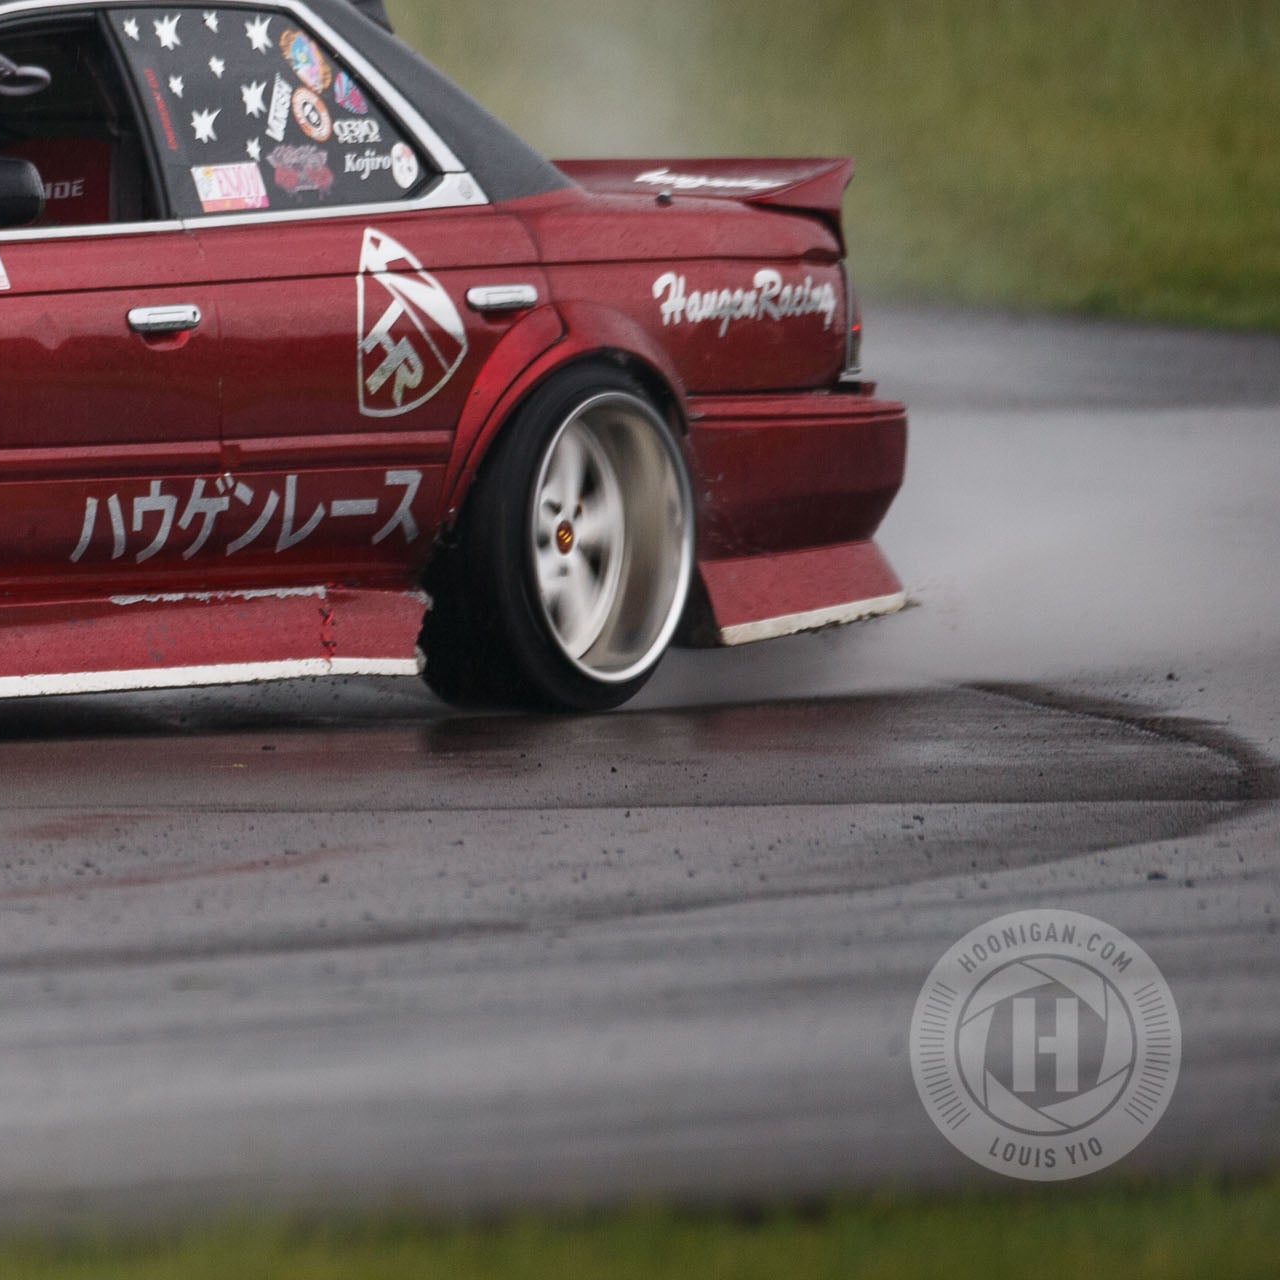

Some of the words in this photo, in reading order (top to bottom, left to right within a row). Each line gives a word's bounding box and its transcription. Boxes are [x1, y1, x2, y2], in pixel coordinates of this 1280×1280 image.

[343, 150, 391, 180] Kojiro
[69, 469, 423, 564] ハウゲンレース
